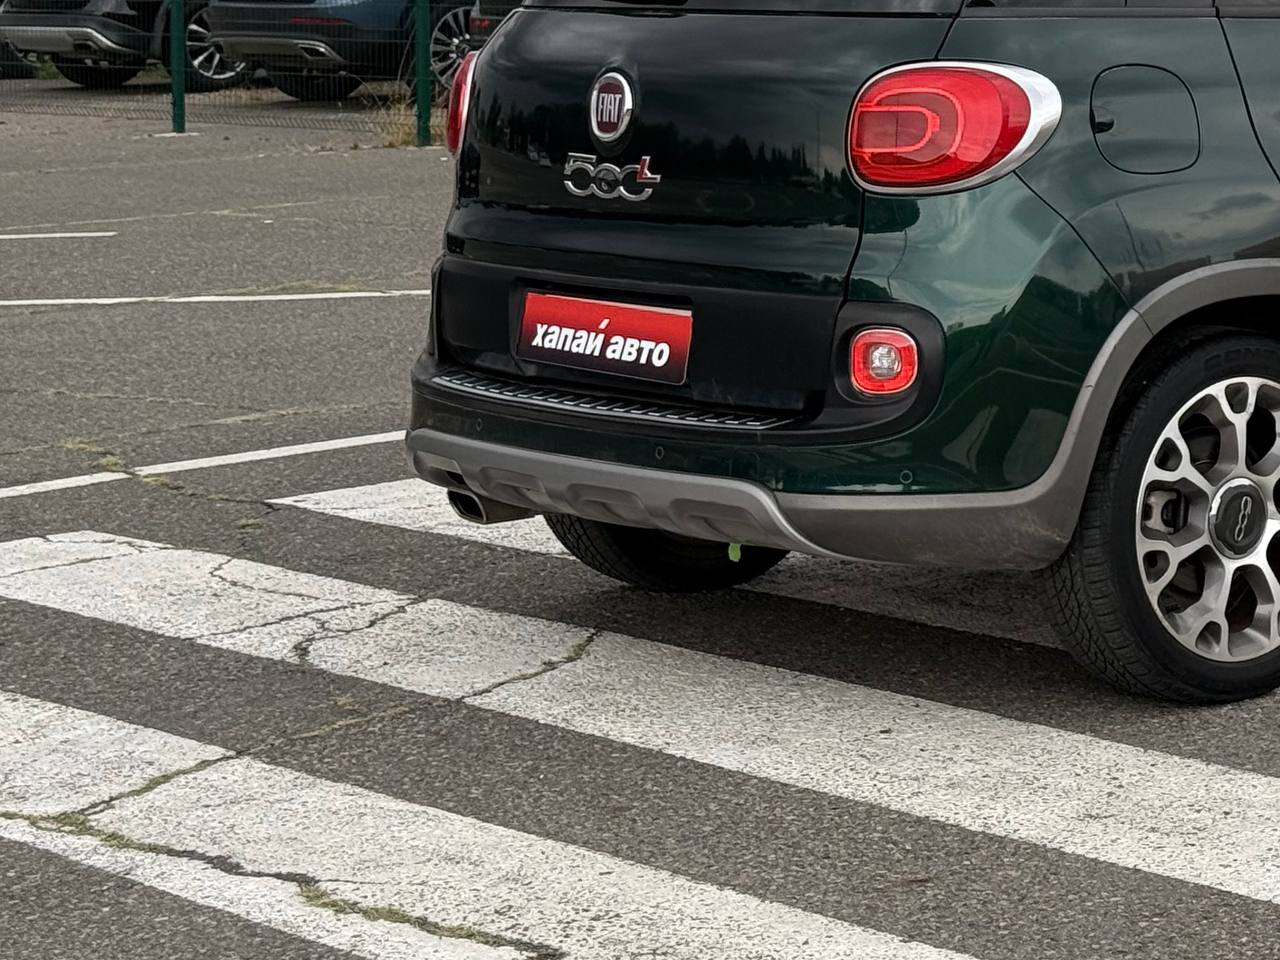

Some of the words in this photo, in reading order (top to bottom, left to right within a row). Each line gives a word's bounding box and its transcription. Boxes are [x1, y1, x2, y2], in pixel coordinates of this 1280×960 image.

[597, 93, 622, 123] FIAT
[563, 152, 662, 202] 500L
[605, 335, 671, 367] авто
